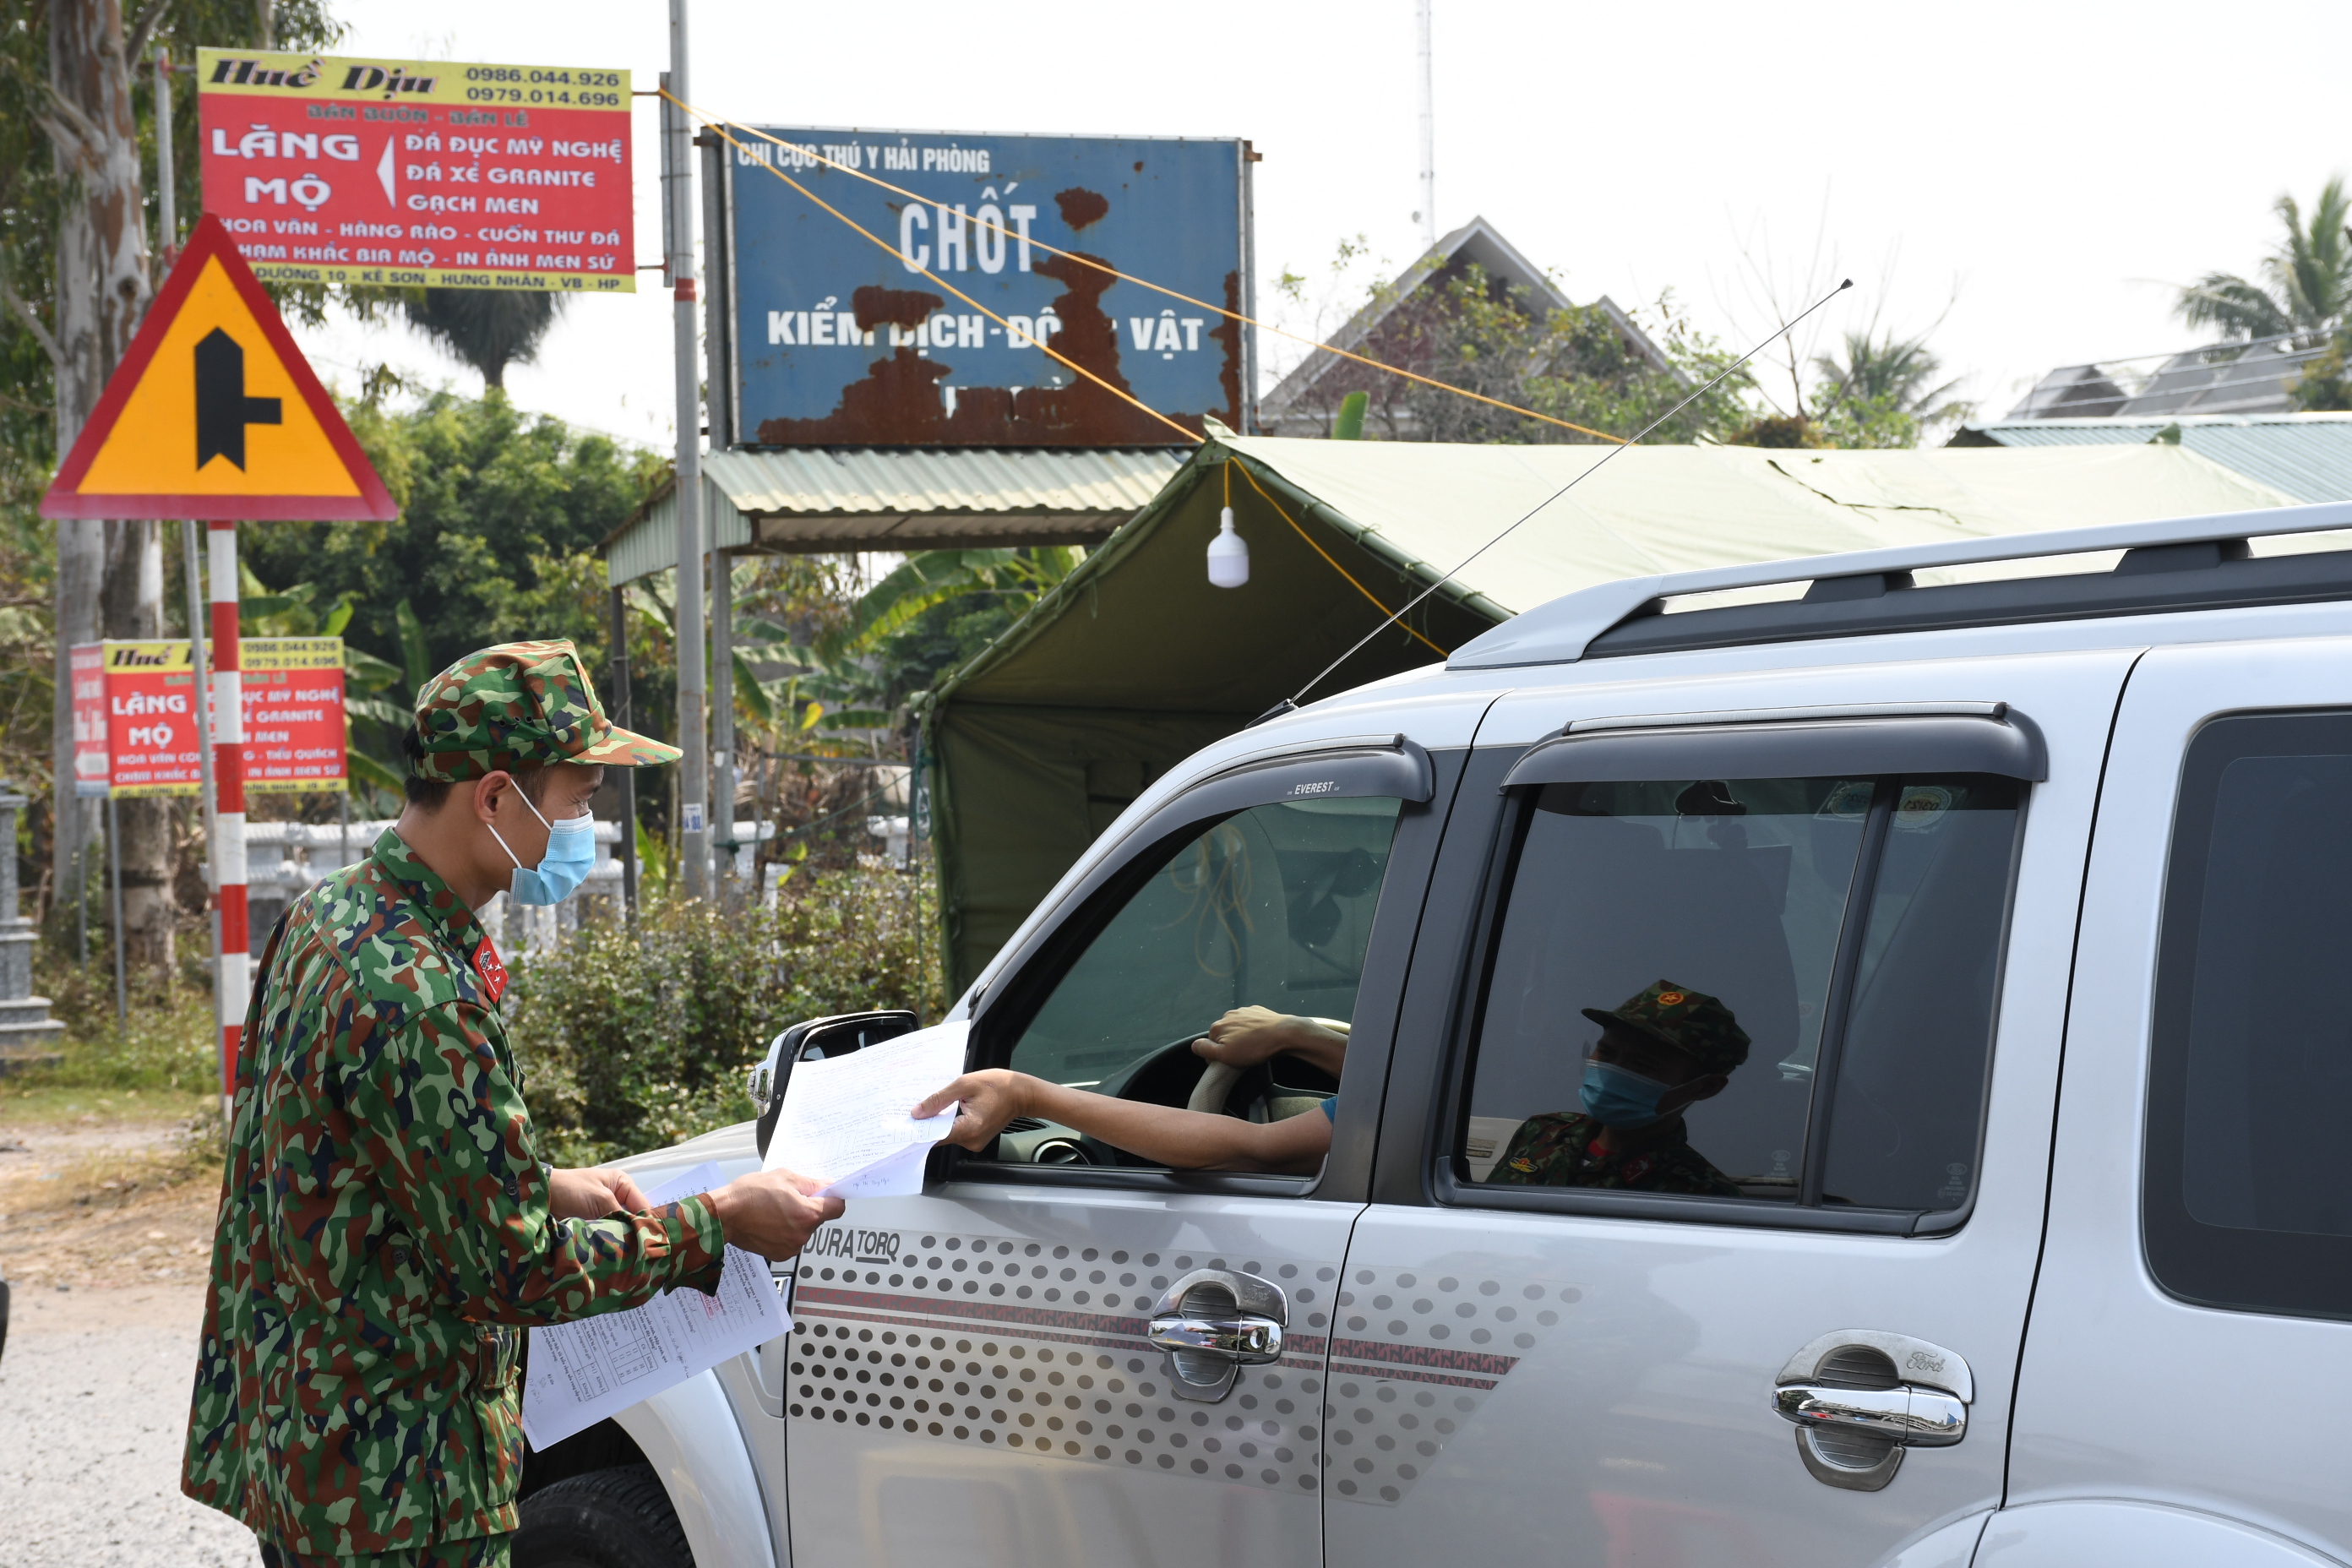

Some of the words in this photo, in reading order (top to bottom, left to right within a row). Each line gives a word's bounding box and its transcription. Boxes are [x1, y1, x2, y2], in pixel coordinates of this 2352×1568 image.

[340, 65, 438, 100] Dịu
[467, 67, 619, 87] 0986.044.926
[467, 87, 619, 106] 0979.014.696
[212, 122, 360, 161] LĂNG
[405, 131, 441, 152] ĐÁ
[449, 136, 499, 158] ĐỤC
[506, 135, 544, 155] MỸ
[552, 139, 622, 164] NGHỆ
[738, 142, 771, 166] CHI
[777, 144, 818, 173] CỤC
[823, 140, 861, 169] THÚ
[866, 146, 879, 169] Y
[885, 138, 917, 171] HẢI
[923, 143, 990, 173] PHÒNG
[406, 161, 442, 182] ĐÁ
[487, 167, 596, 188] GRANITE
[244, 172, 332, 212] MỘ
[406, 193, 477, 215] GẠCH
[484, 197, 539, 215] MEN
[273, 217, 318, 235] VĂN
[339, 220, 404, 238] HÀNG
[410, 221, 457, 240] RÀO
[477, 224, 538, 243] CUỐN
[543, 229, 585, 245] THƯ
[590, 229, 621, 246] ĐÁ
[900, 182, 1037, 275] CHỐT
[237, 243, 287, 261] HẠM
[293, 241, 351, 262] KHẮC
[356, 248, 392, 263] BIA
[398, 248, 436, 269] MỘ
[455, 252, 478, 266] IN
[536, 254, 580, 270] MEN
[587, 253, 616, 270] SỨ
[328, 270, 346, 281] 10
[561, 277, 583, 288] VB
[598, 279, 620, 289] HP
[1129, 308, 1204, 361] VẬT
[112, 691, 187, 717] LĂNG
[128, 721, 174, 749] MỘ
[1294, 781, 1335, 795] EVEREST
[1906, 1351, 1946, 1373] Ford
